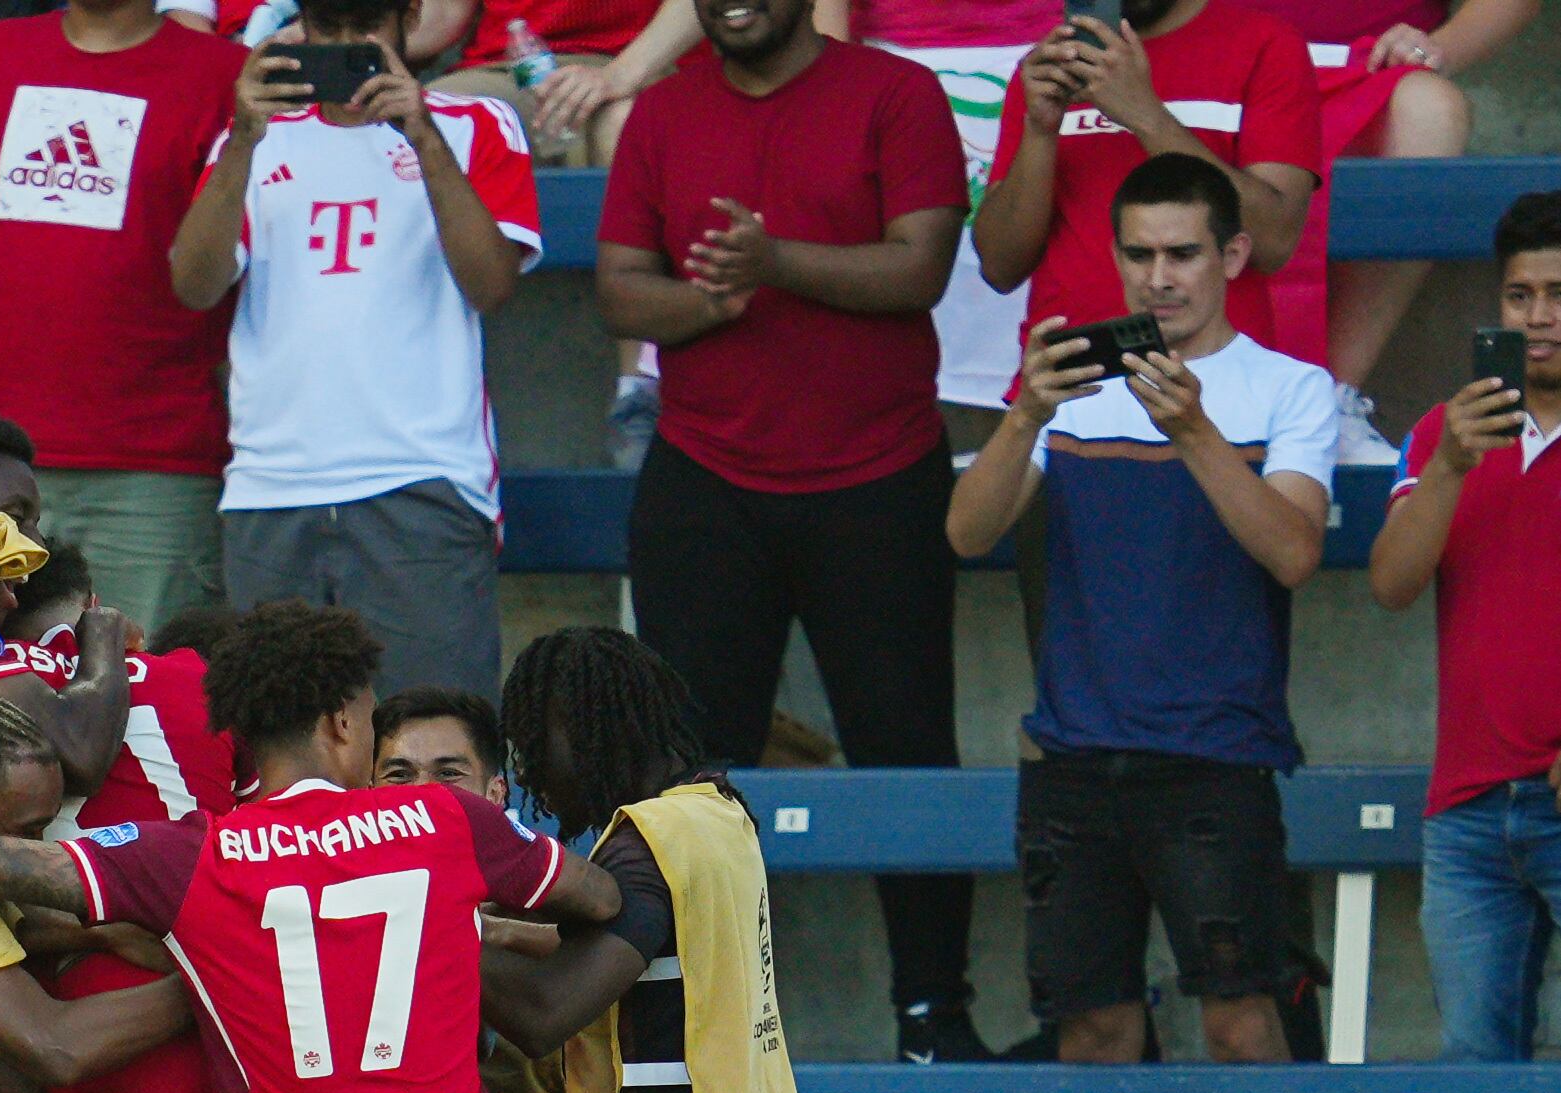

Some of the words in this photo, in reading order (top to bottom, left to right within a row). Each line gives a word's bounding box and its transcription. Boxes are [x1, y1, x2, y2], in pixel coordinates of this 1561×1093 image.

[10, 167, 115, 195] adidas
[309, 198, 378, 275] T
[219, 800, 436, 862] BUCHANAN
[261, 868, 430, 1079] 17
